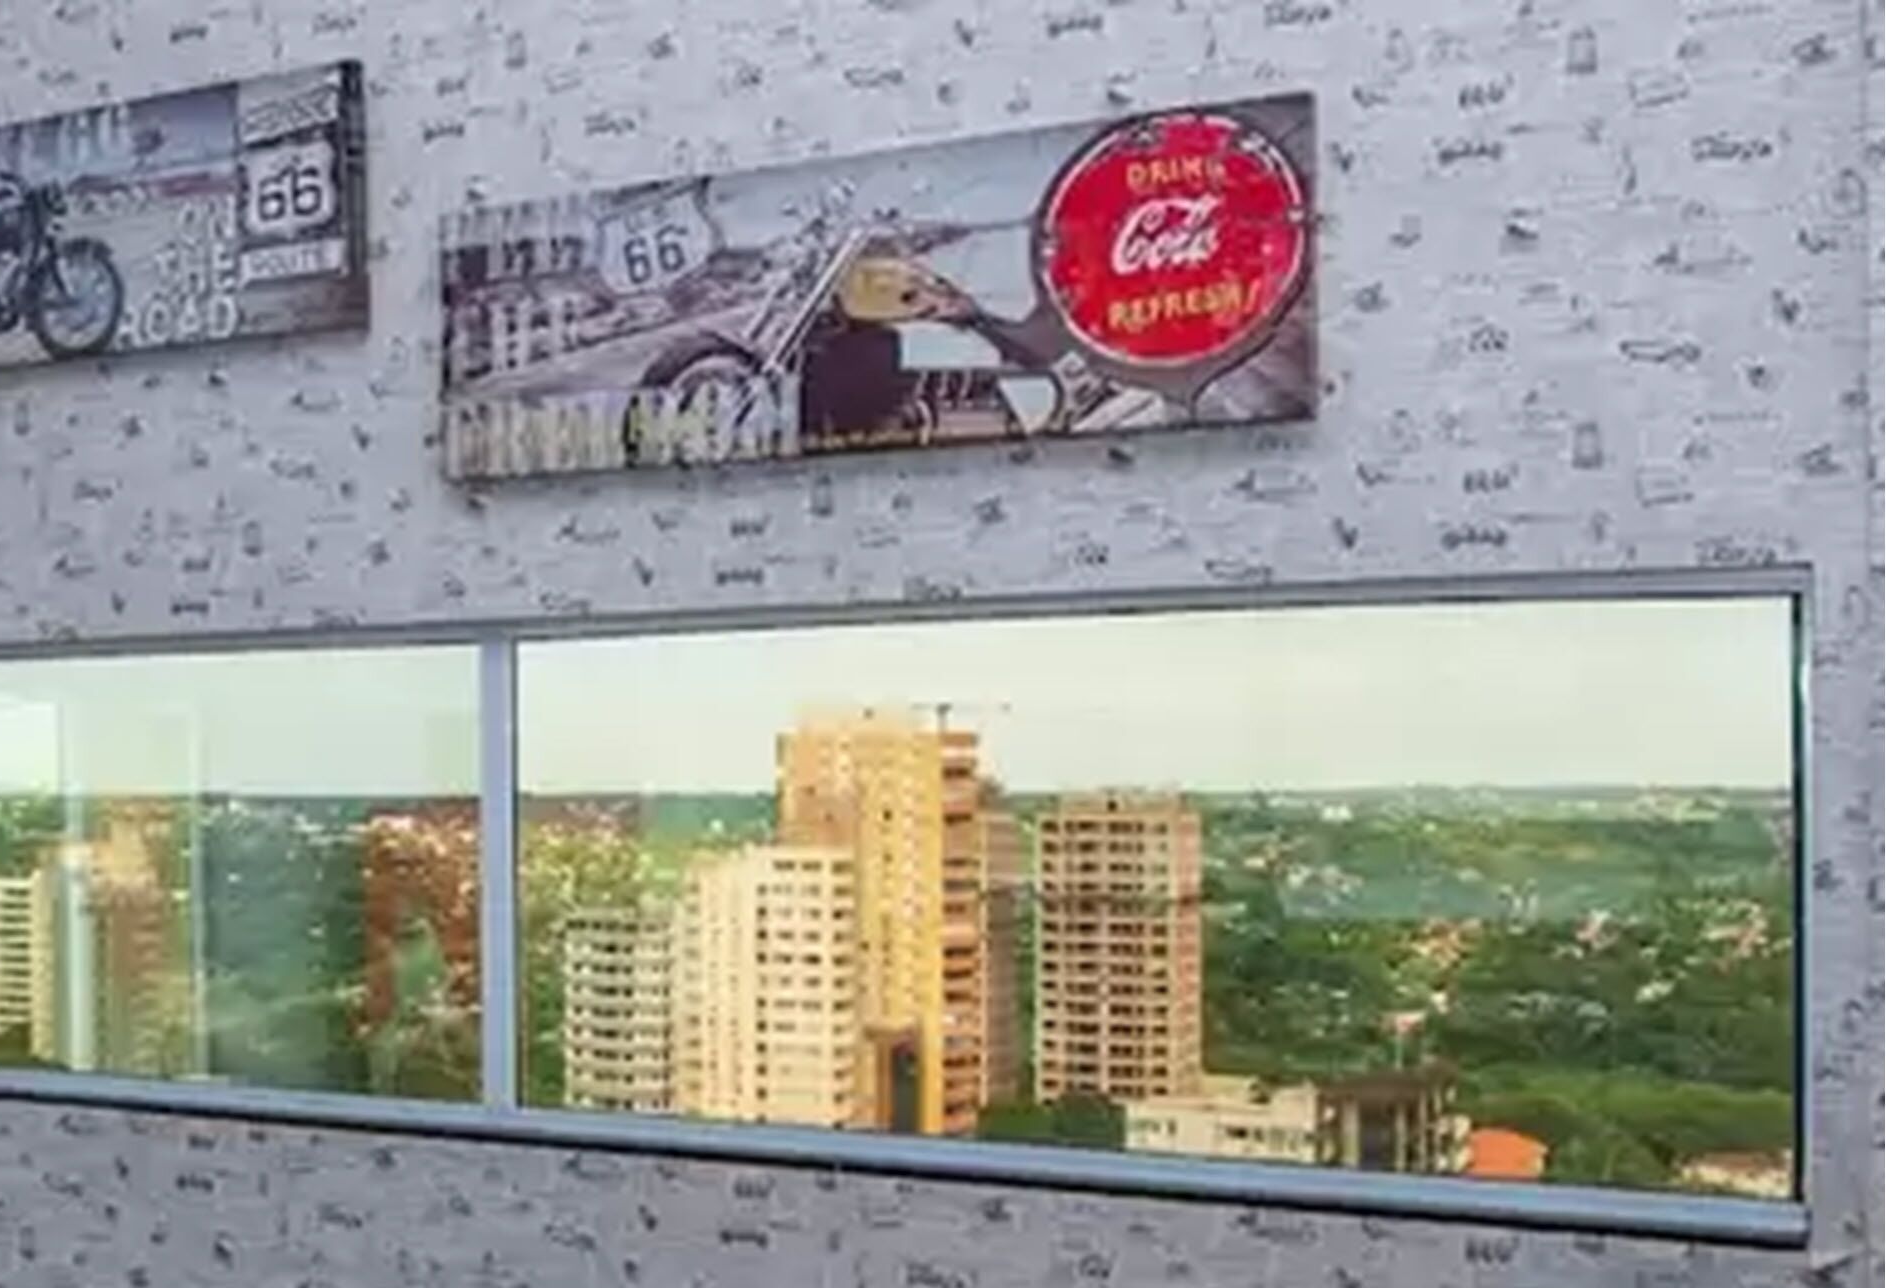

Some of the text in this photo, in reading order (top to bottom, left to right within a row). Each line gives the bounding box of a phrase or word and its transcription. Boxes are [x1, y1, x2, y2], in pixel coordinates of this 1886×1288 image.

[258, 164, 323, 222] 66
[623, 223, 689, 285] 66
[116, 295, 237, 348] ROAD
